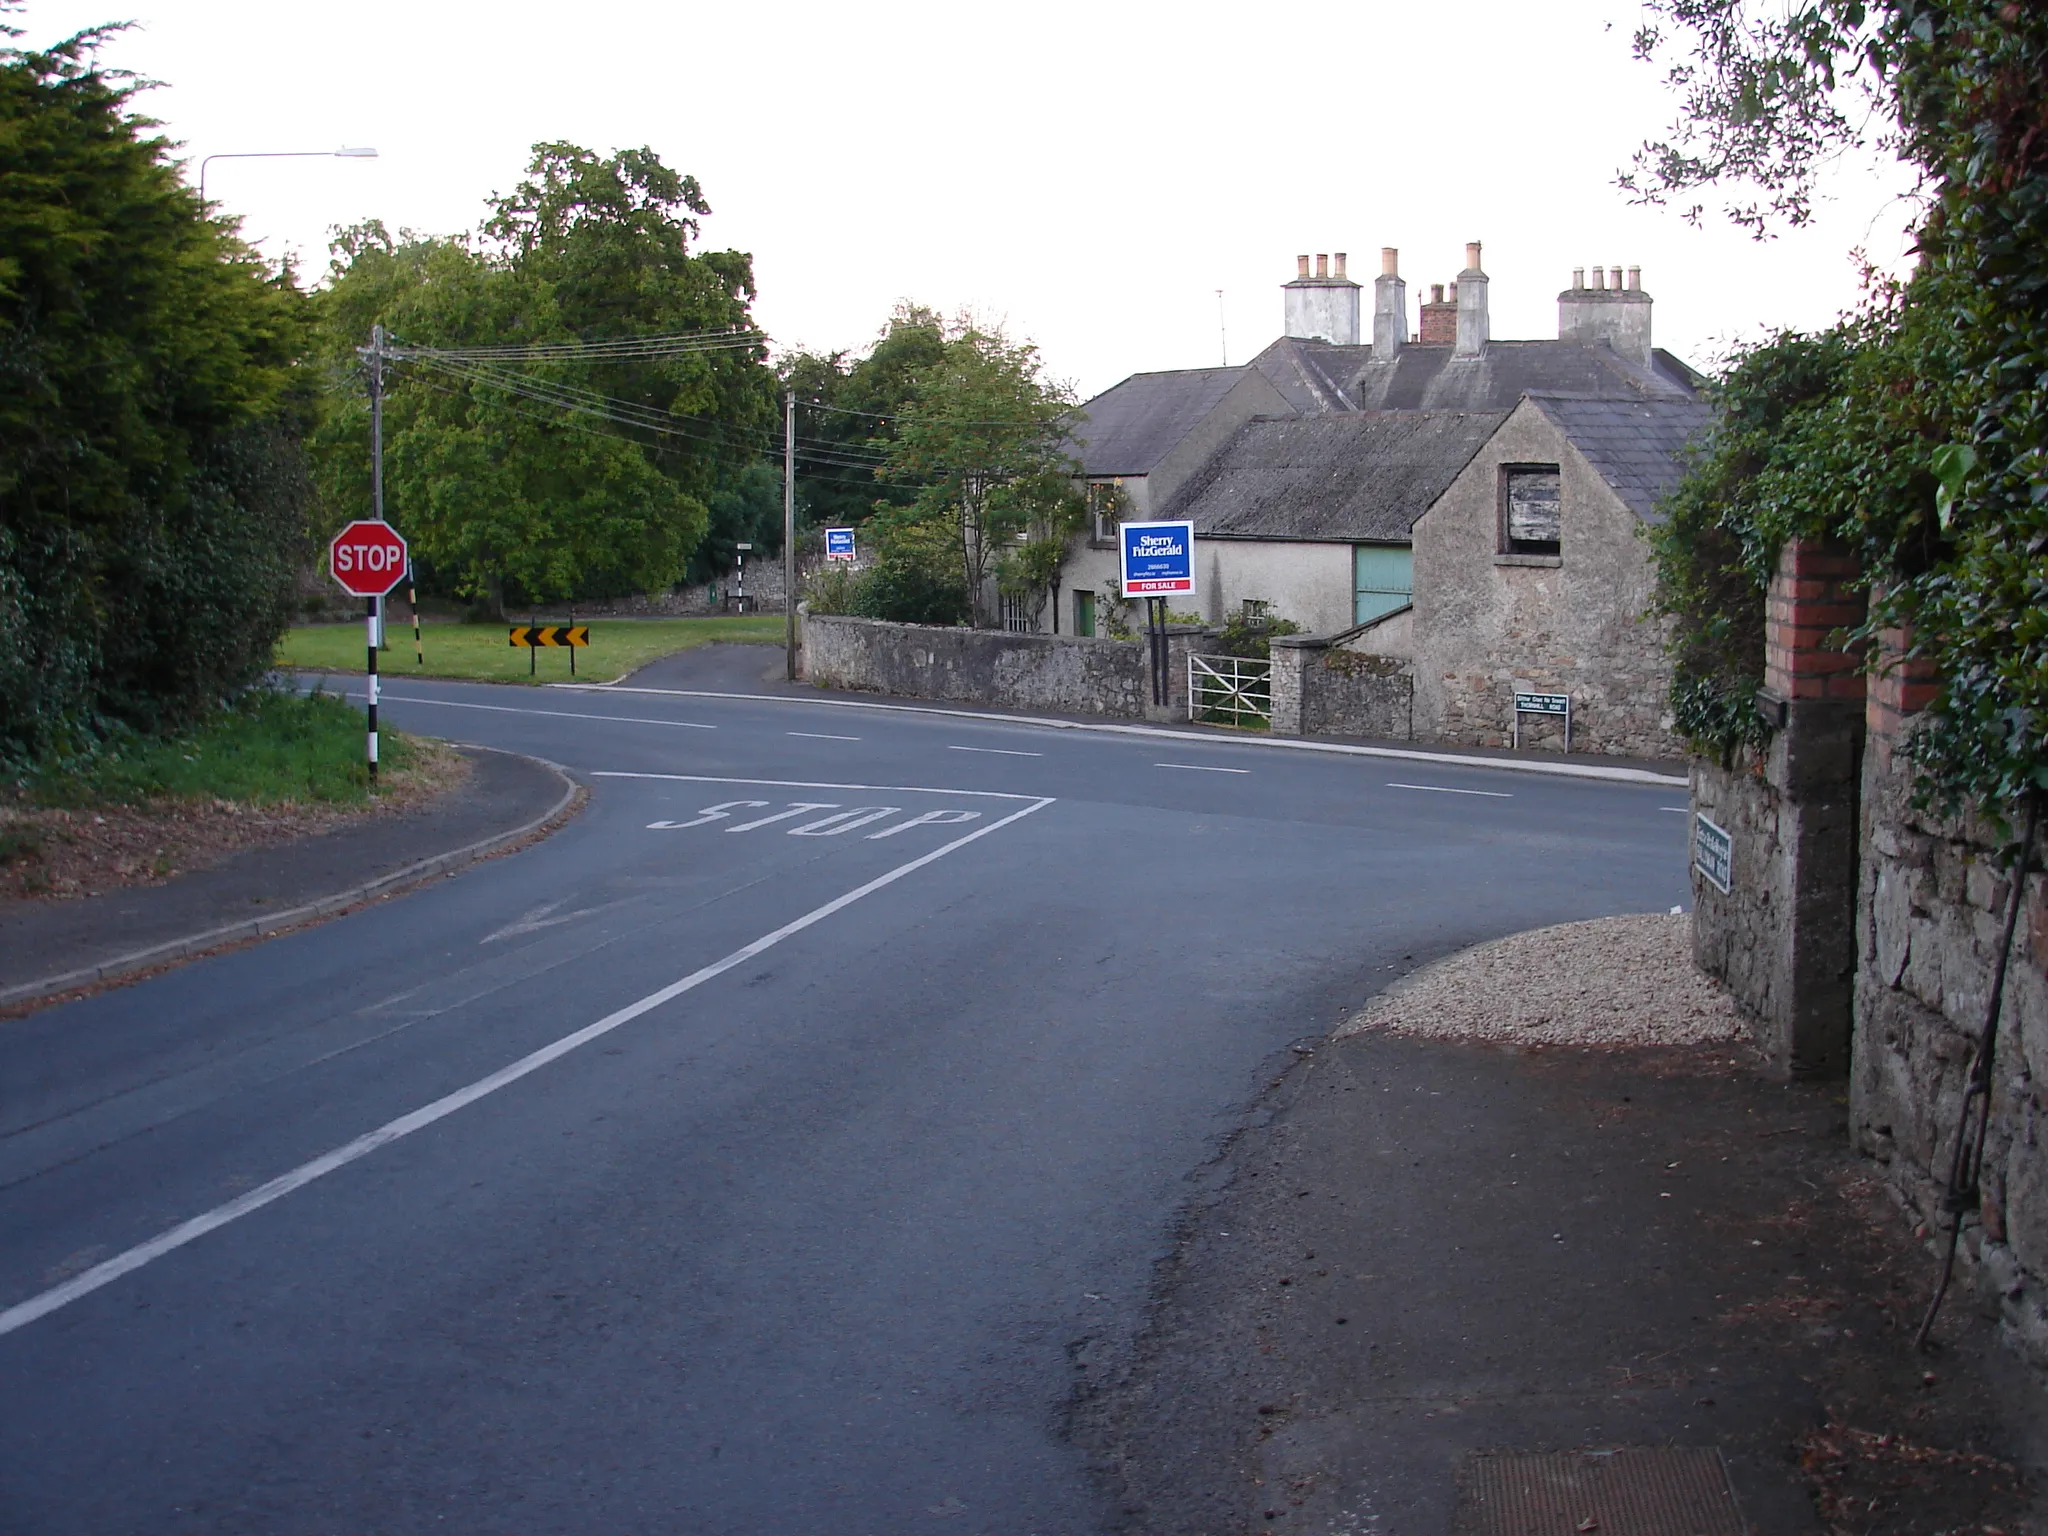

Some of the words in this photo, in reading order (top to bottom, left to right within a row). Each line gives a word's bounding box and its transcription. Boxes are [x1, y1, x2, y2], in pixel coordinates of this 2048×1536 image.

[1140, 536, 1173, 548] Sherry
[1132, 544, 1182, 557] FitzGerald
[338, 544, 401, 571] STOP
[1141, 583, 1157, 591] FOR
[1157, 582, 1176, 590] SALE
[646, 801, 982, 839] STOP
